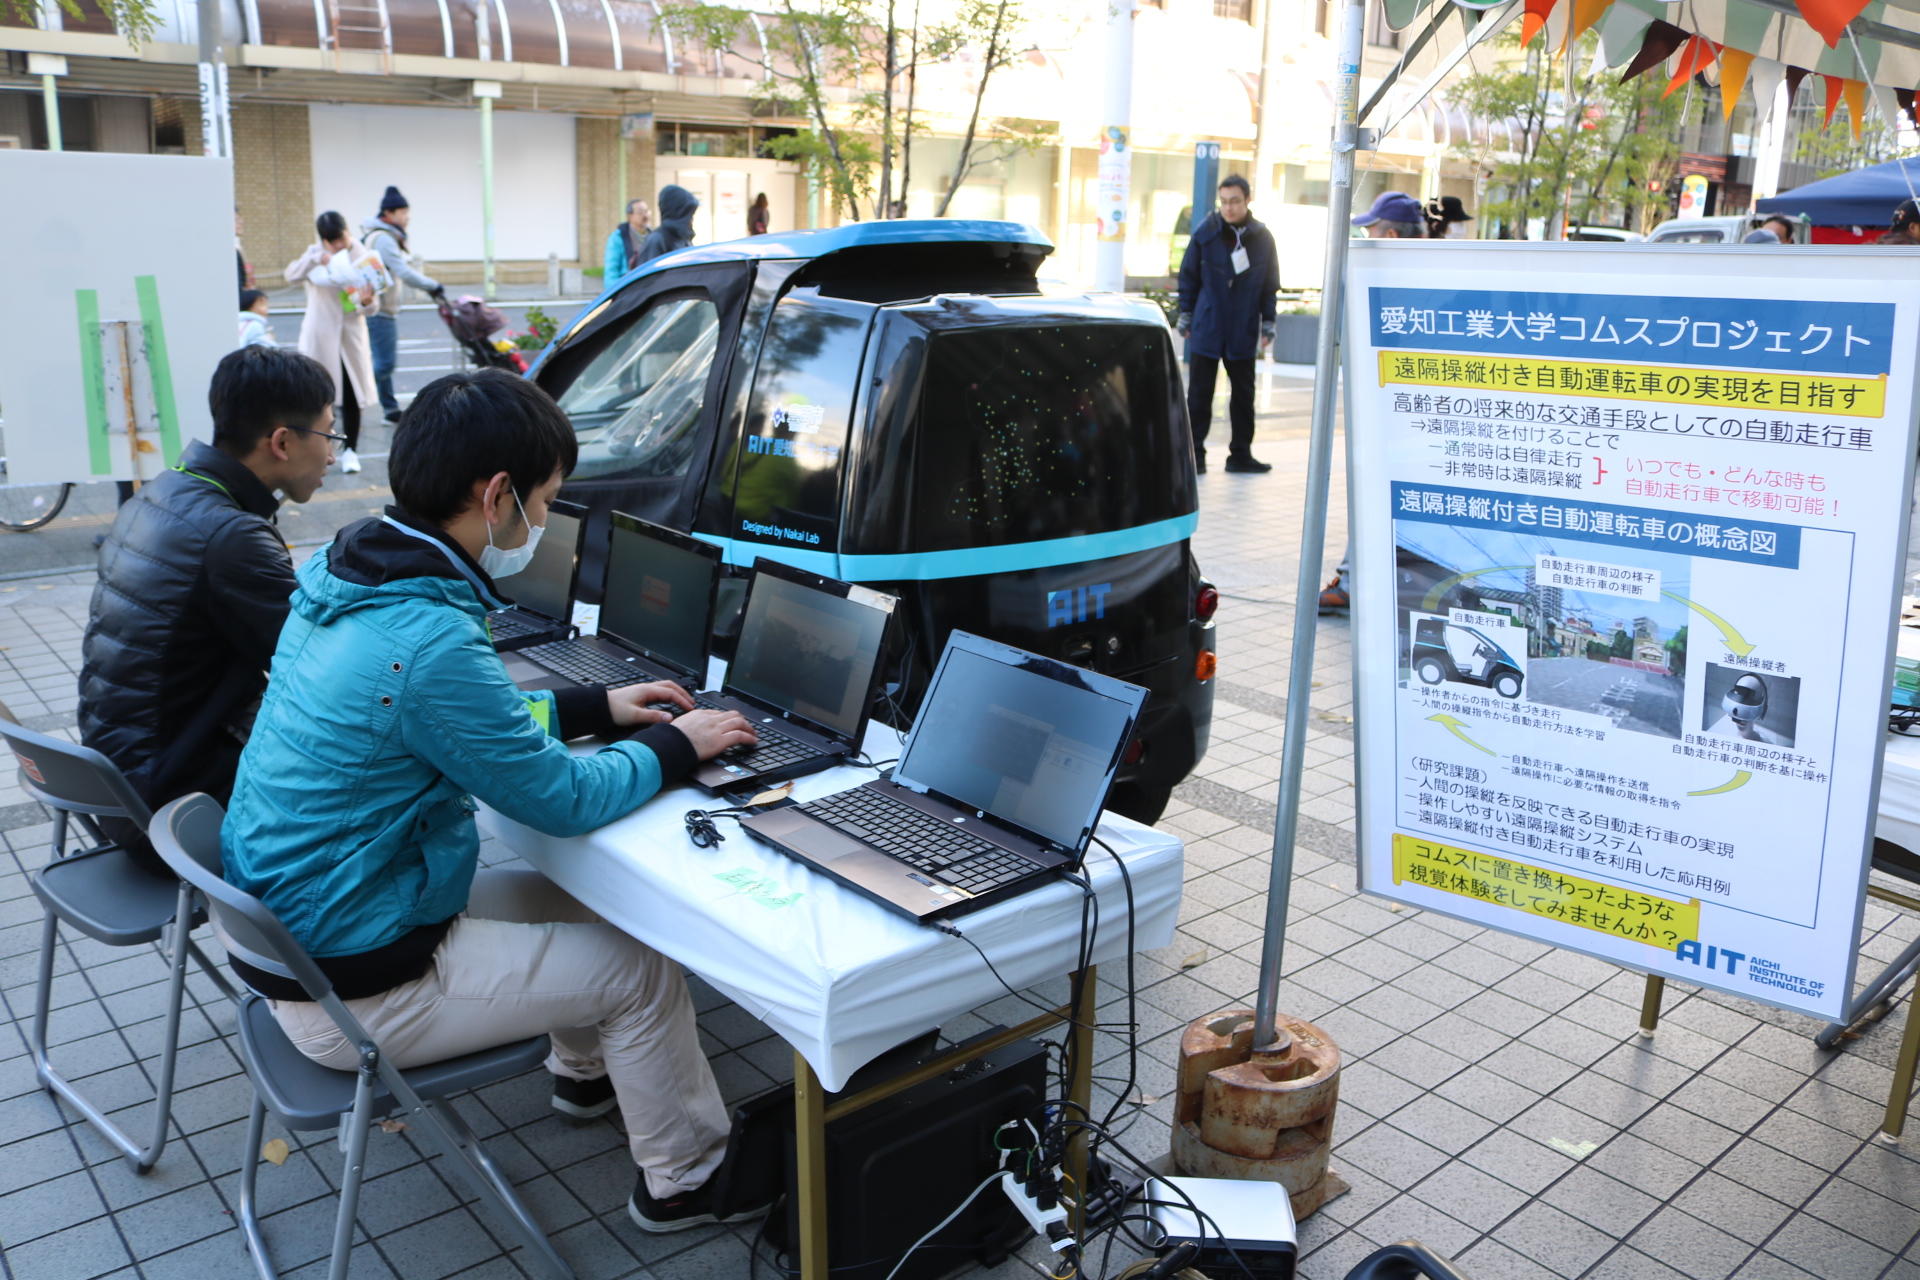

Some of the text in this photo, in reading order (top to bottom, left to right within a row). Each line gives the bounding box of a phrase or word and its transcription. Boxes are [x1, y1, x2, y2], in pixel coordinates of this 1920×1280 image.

[1381, 306, 1871, 357] 愛知工業大学コムスプロジェクト
[1394, 358, 1866, 409] 遠隔操縦付き自動運転車の実現を目指す
[1393, 392, 1872, 450] 高齢者の将来的な交通手段としての自動走行車
[1625, 456, 1827, 492] いつでも・どんな時も
[1625, 478, 1840, 517] 自動走行車で移動可能！
[742, 519, 820, 544] Designed by Nakai Lab
[1400, 489, 1777, 556] 遠隔操縦付き自動運転車の概念図
[1541, 559, 1656, 584] 自動走行車周辺の様子
[1552, 573, 1643, 595] 自動走行車の判断
[1047, 582, 1112, 628] AIT
[1454, 612, 1506, 629] 自動走行車
[1672, 743, 1829, 784] 自動走行車の判断を基に操作
[1684, 733, 1817, 769] 自動走行車周辺の様子と
[1414, 843, 1676, 922] コムスに置き換わったような
[1408, 862, 1678, 946] 視覚体験をしてみませんか？
[1676, 939, 1746, 975] AIT
[1750, 956, 1781, 971] AICHI
[1748, 973, 1824, 998] TECHNOLOGY
[1749, 964, 1825, 990] INSTITUTE OF
